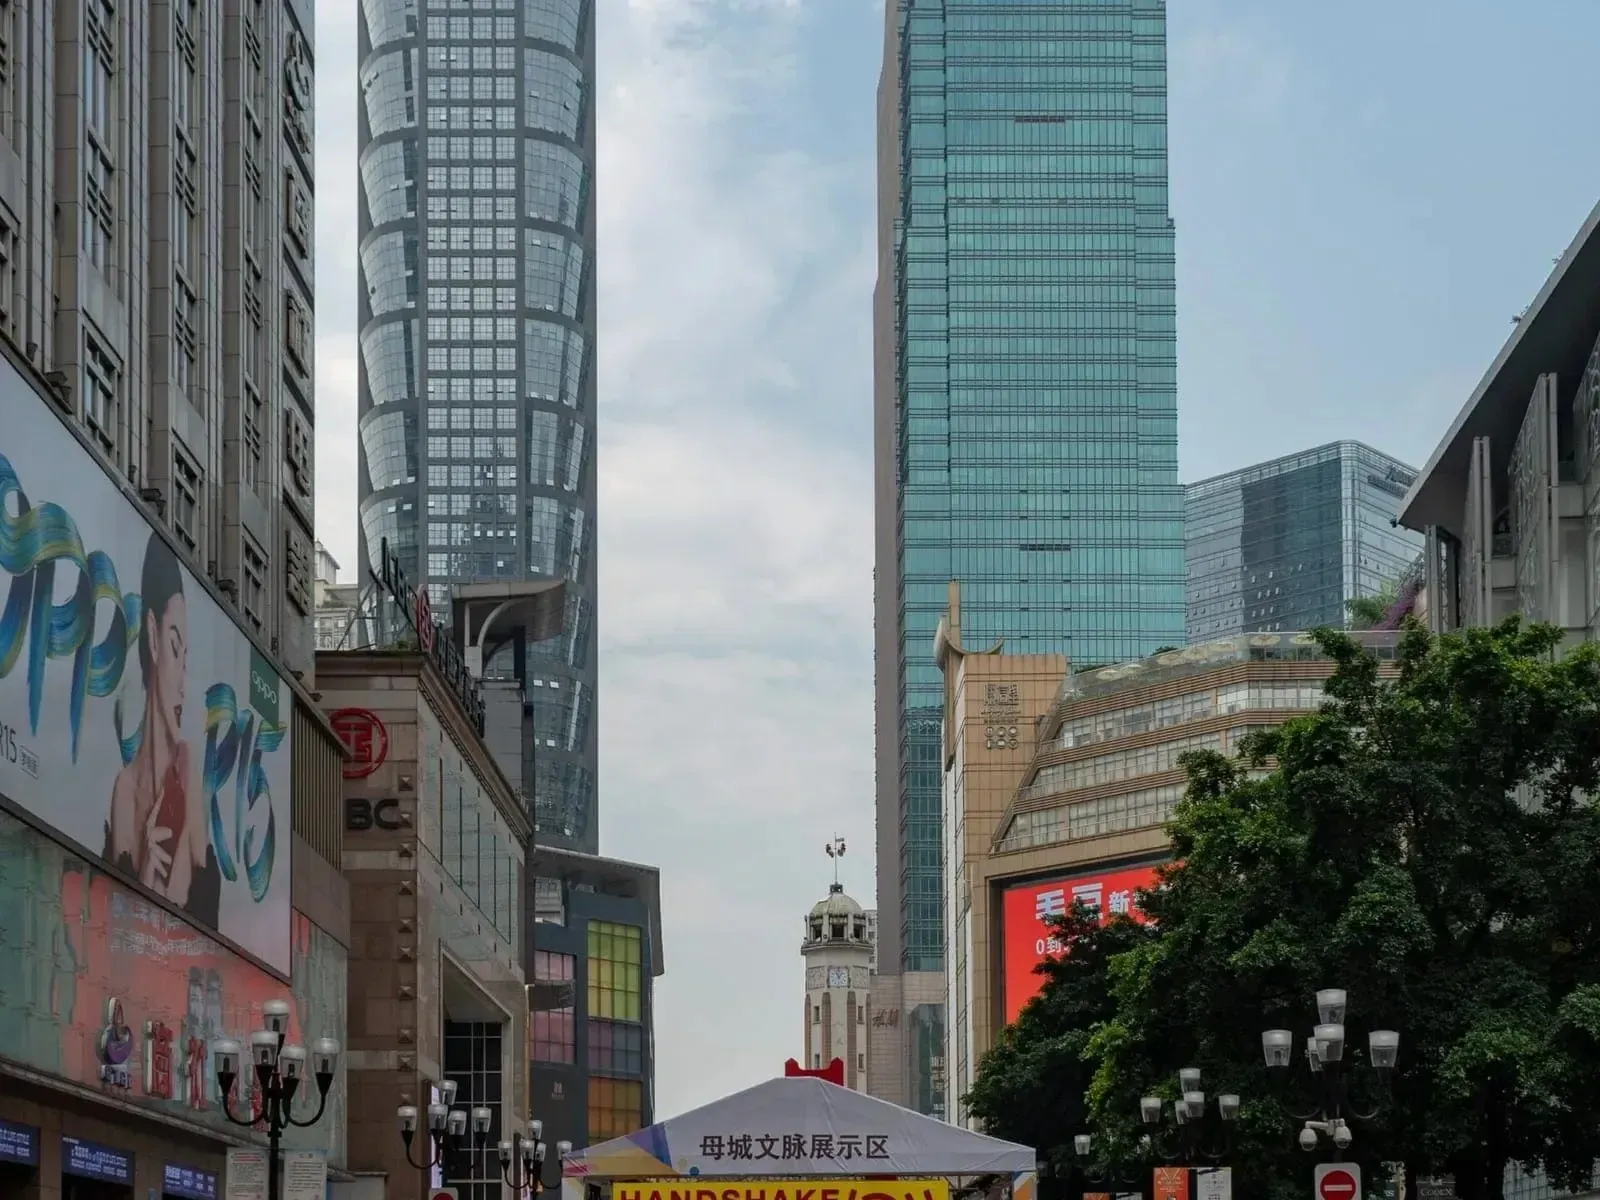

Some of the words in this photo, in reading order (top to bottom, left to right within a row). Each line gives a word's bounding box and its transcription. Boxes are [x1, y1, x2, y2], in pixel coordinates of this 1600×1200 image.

[252, 670, 277, 704] oppo
[699, 1133, 890, 1160] 母城文脉展示区
